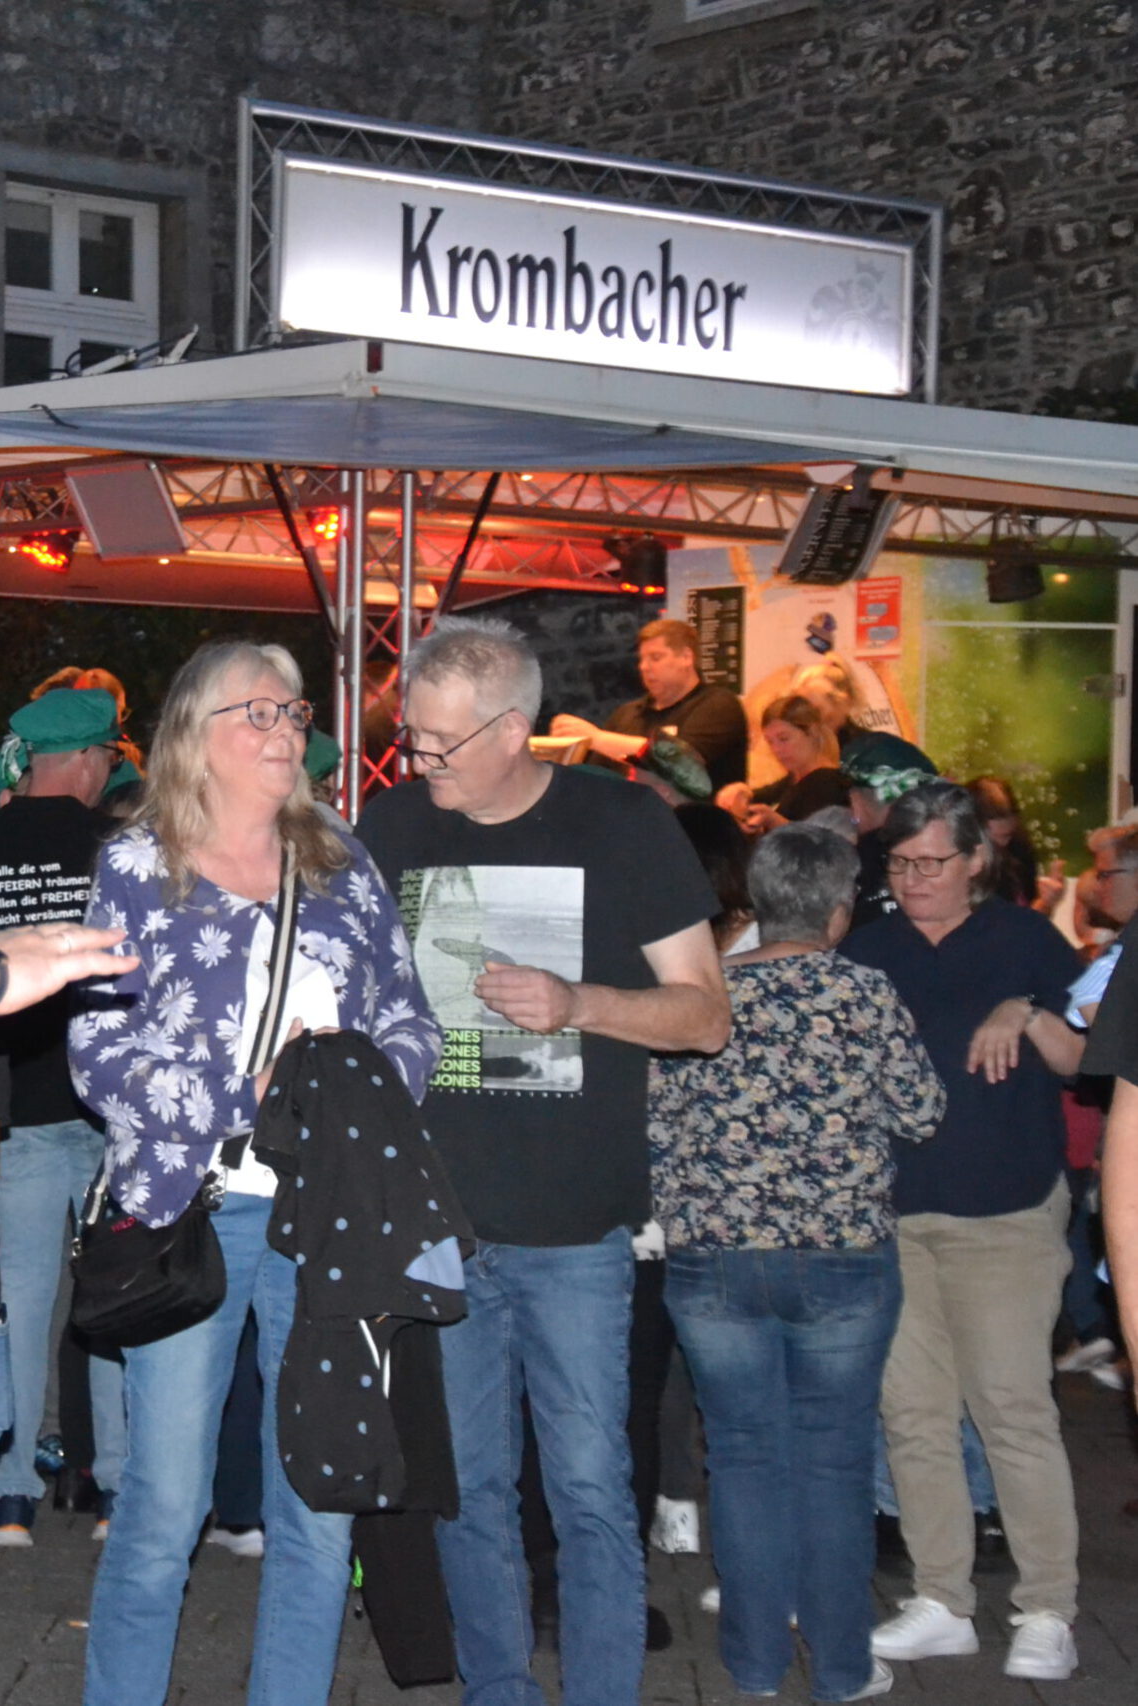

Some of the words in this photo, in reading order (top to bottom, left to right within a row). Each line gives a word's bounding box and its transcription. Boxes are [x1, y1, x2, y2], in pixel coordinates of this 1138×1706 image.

[399, 202, 747, 352] Krombacher
[18, 863, 36, 875] die
[39, 862, 61, 873] vom
[45, 876, 91, 888] träumen
[20, 895, 38, 906] die
[41, 890, 91, 904] FREIHEI
[443, 1029, 481, 1043] ONES
[442, 1044, 481, 1058] ONES
